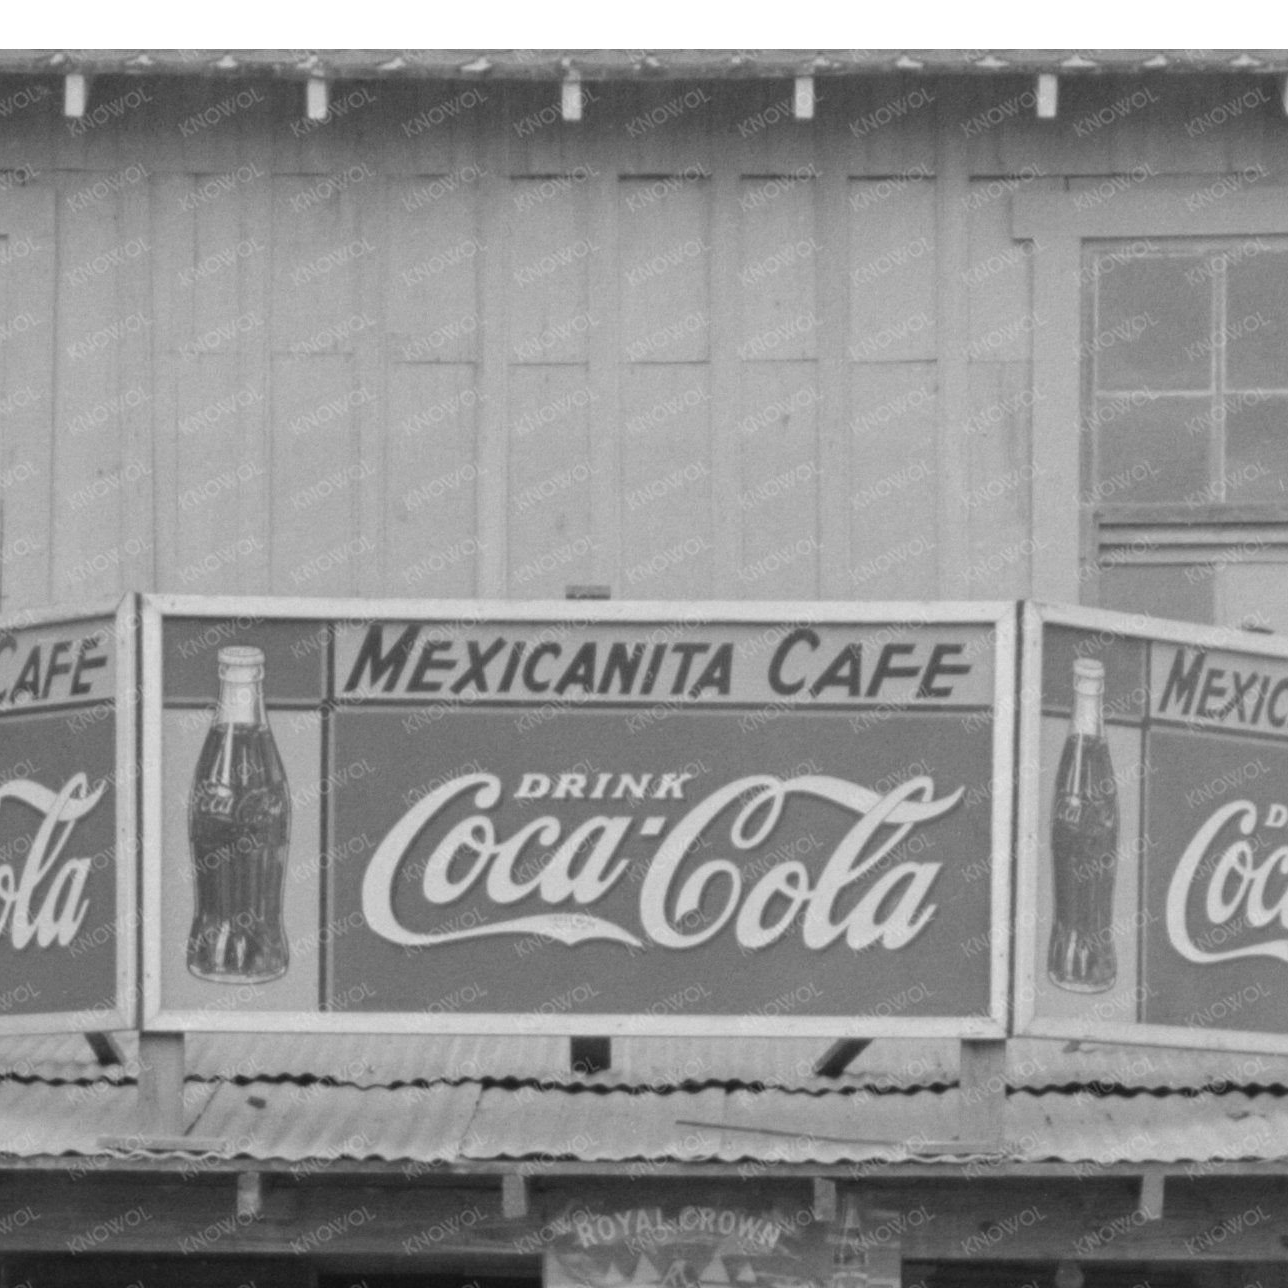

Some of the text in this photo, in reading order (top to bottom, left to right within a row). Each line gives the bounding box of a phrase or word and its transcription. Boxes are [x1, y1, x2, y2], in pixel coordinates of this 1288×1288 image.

[343, 624, 974, 699] MEXICANITA CAFE
[513, 773, 693, 799] DRINK
[361, 774, 967, 950] Coca-Cola
[575, 1205, 782, 1250] ROYAL CROWN
